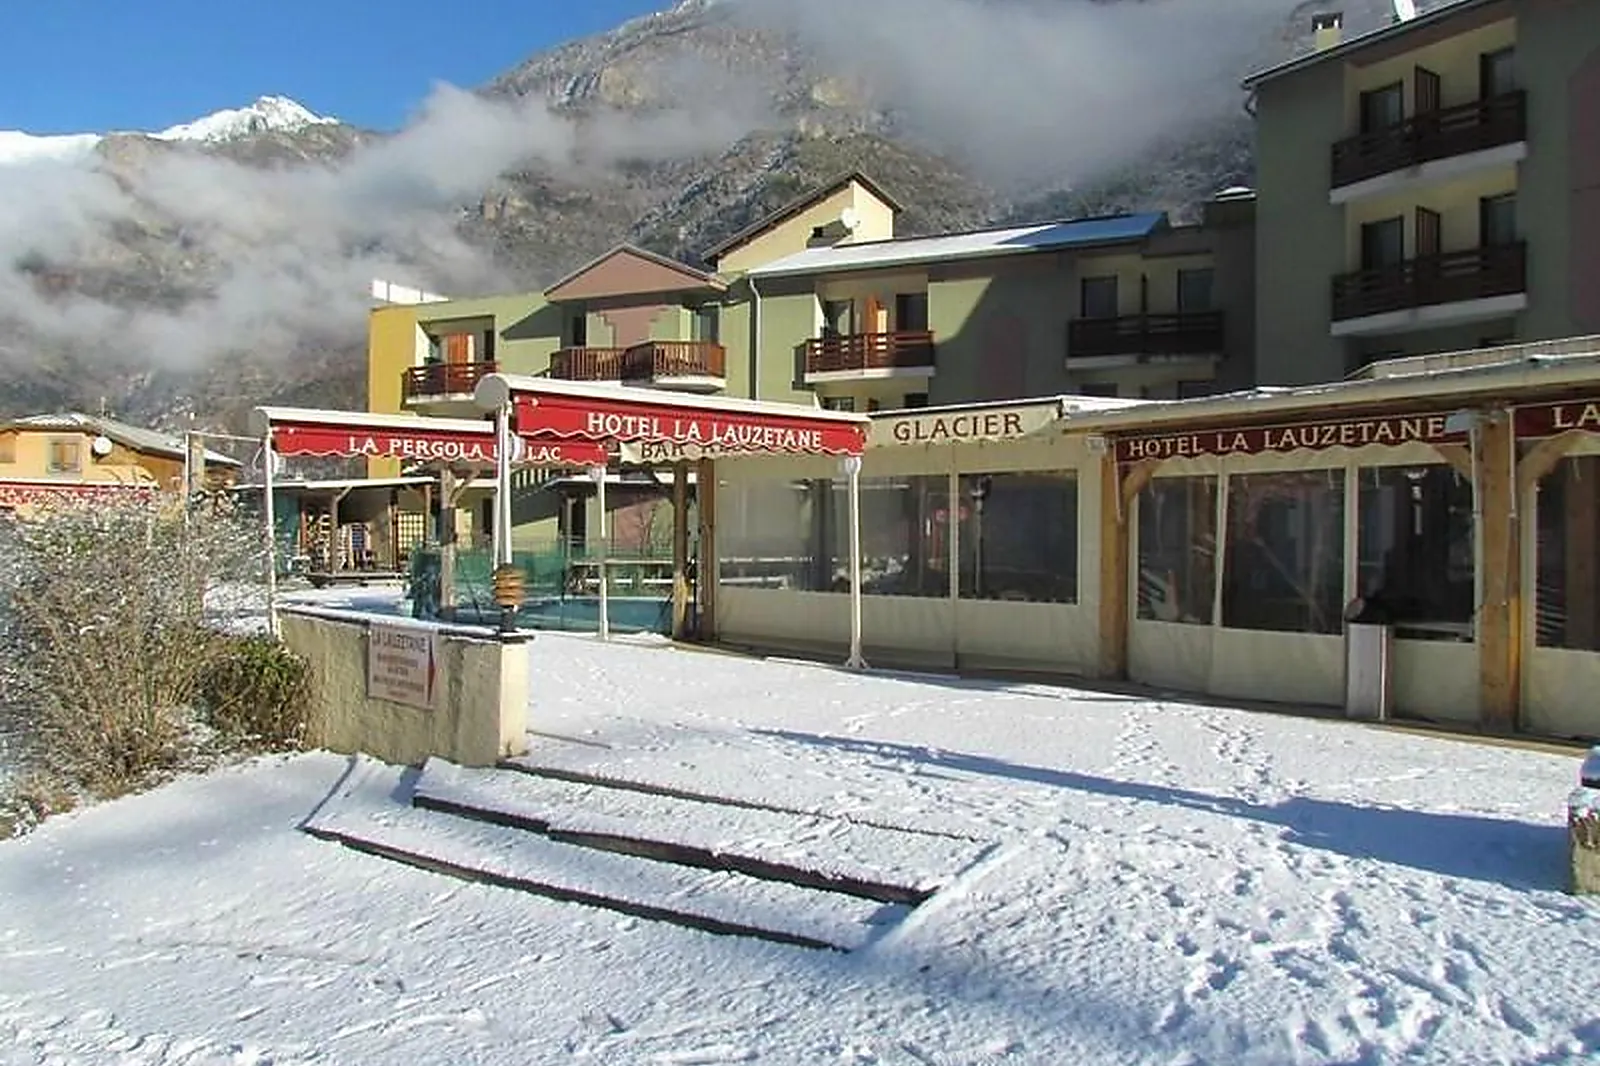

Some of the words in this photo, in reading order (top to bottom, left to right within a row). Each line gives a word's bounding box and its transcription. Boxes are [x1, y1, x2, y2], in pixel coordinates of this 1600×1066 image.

[588, 412, 664, 437] HOTEL
[674, 419, 707, 440] LA
[712, 422, 822, 448] LAUZETANE
[893, 412, 1024, 441] GLACIER
[1553, 403, 1600, 428] LA
[348, 436, 379, 454] LA
[388, 438, 485, 459] PERGOLA
[527, 445, 562, 461] LAC
[1128, 435, 1204, 457] HOTEL
[1216, 432, 1249, 451] LA
[1263, 416, 1446, 449] LAUZETANE
